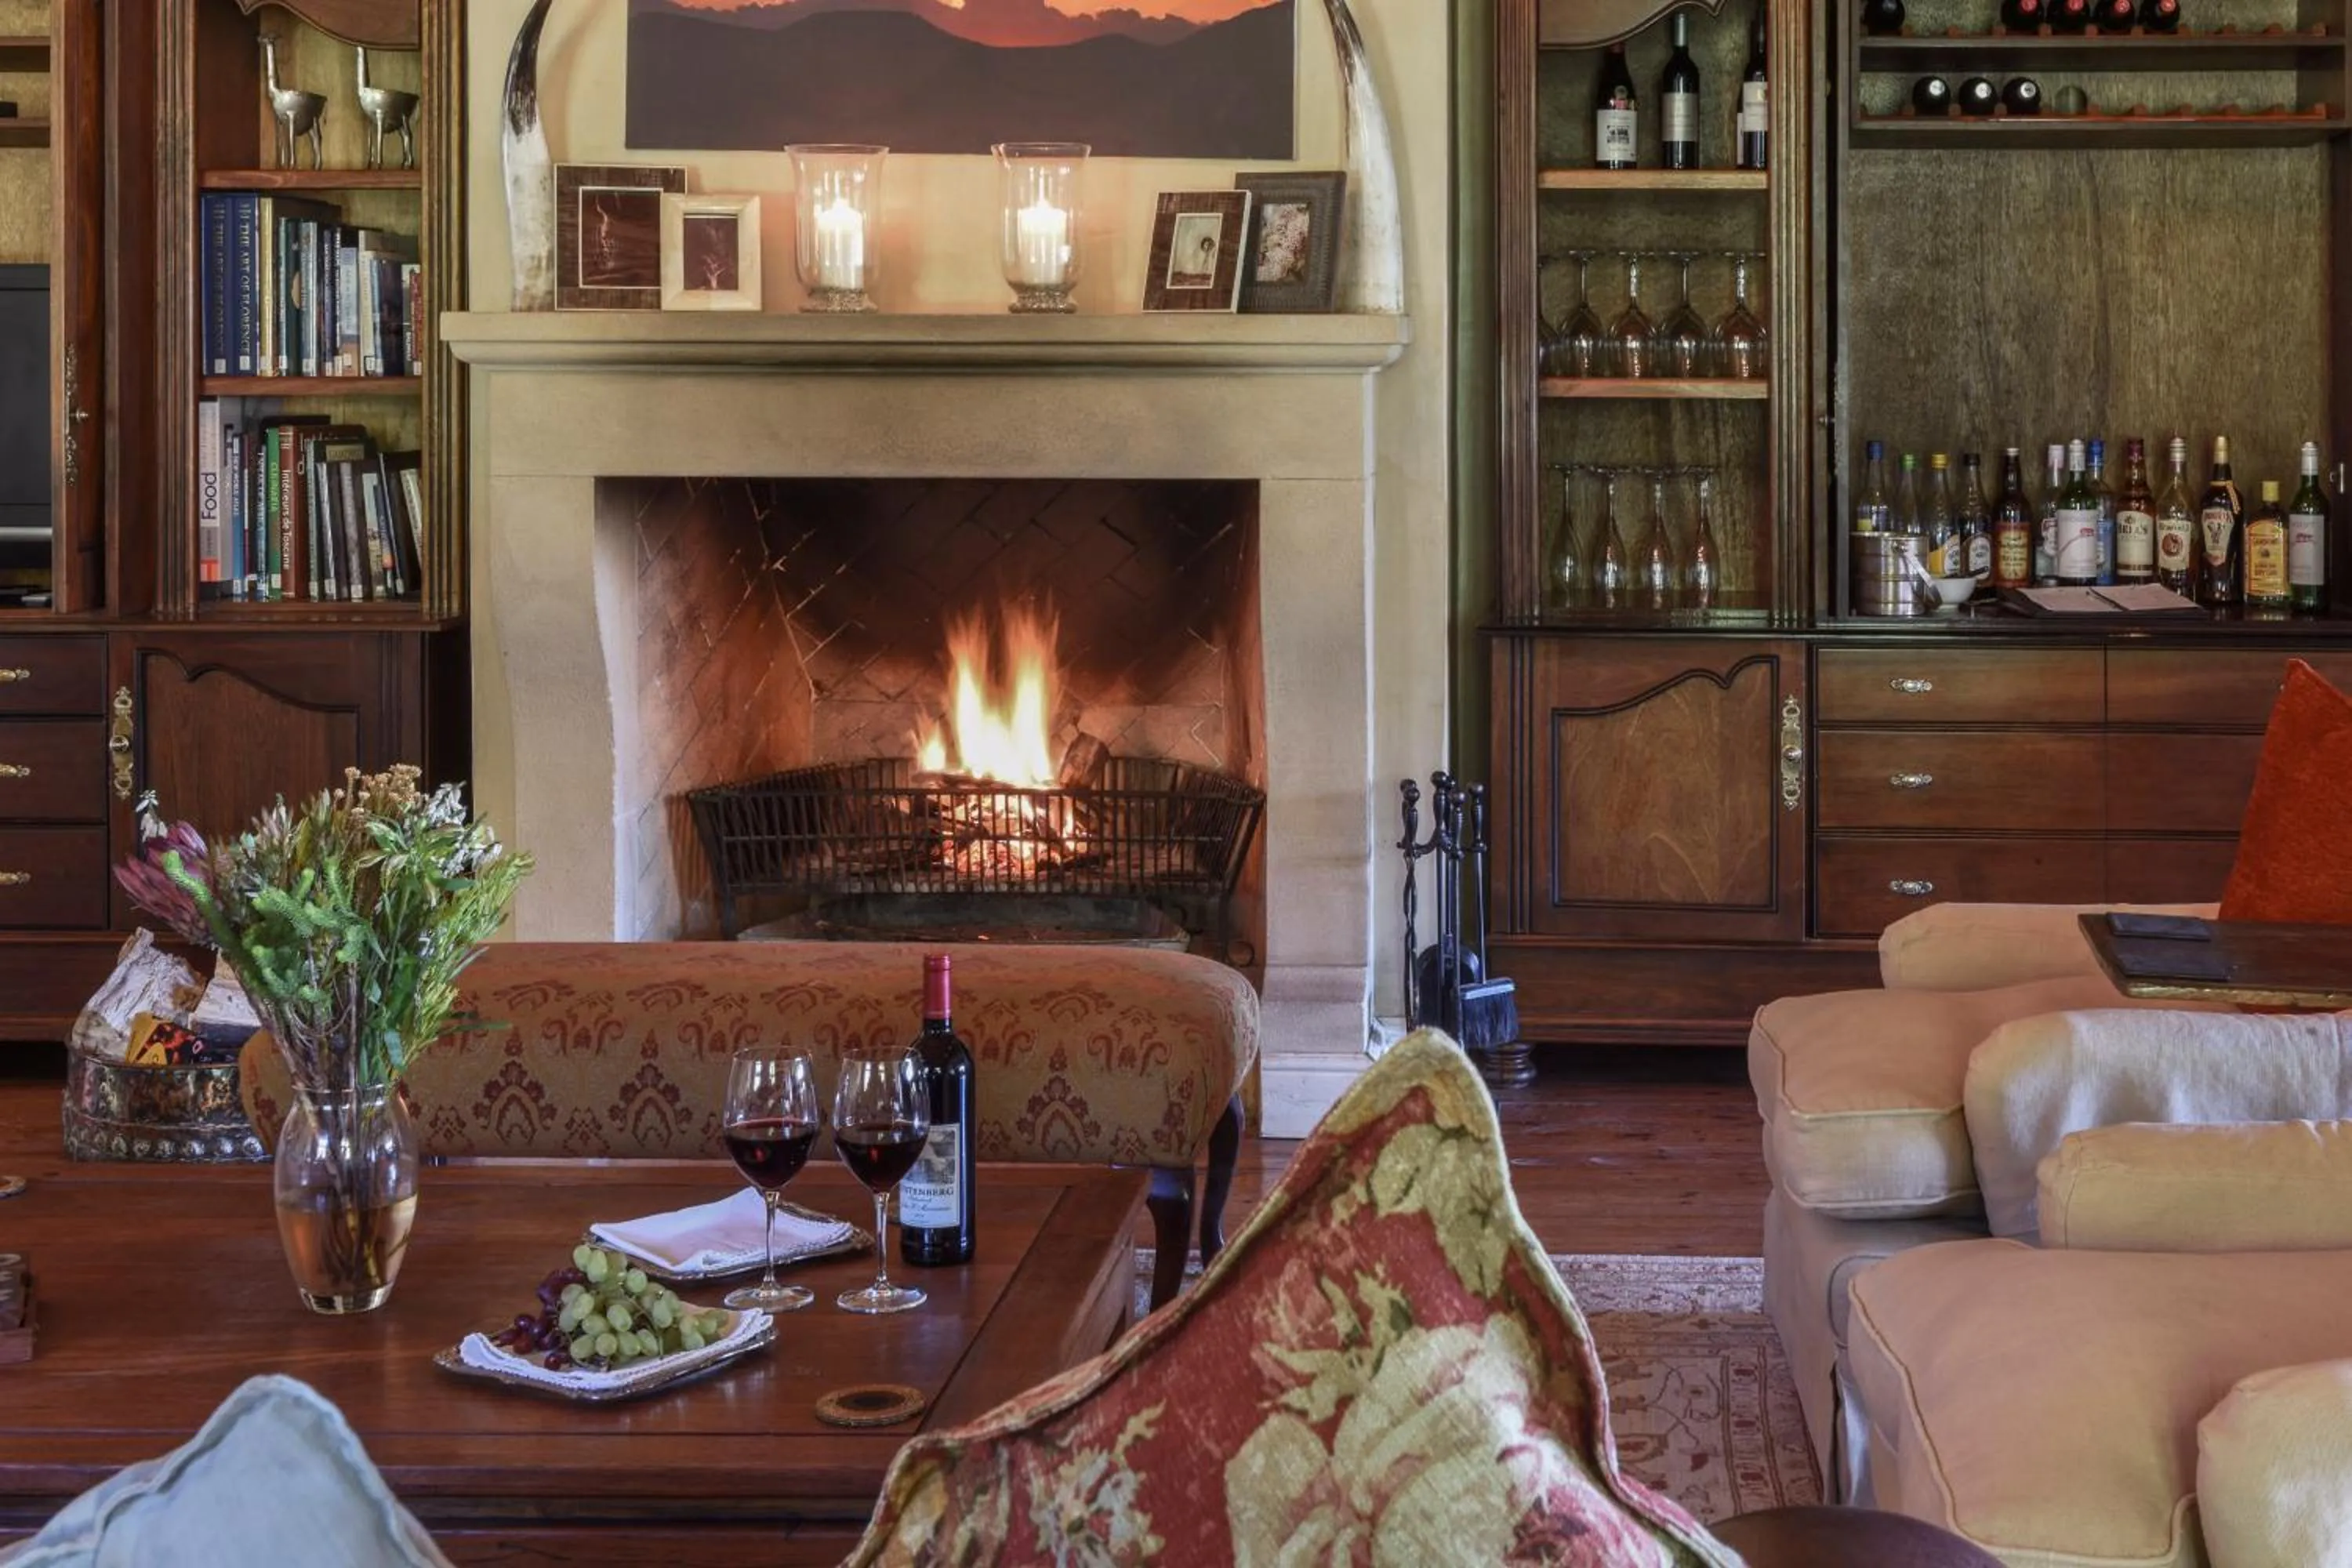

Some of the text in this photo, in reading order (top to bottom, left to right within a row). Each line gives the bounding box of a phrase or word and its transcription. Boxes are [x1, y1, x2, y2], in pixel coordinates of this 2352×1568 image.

[212, 223, 224, 247] THE
[239, 223, 250, 356] THE ART OF FLORENCE
[201, 472, 216, 521] Food
[281, 517, 292, 529] de
[282, 532, 292, 570] Toscane
[903, 1185, 954, 1196] STENBERG
